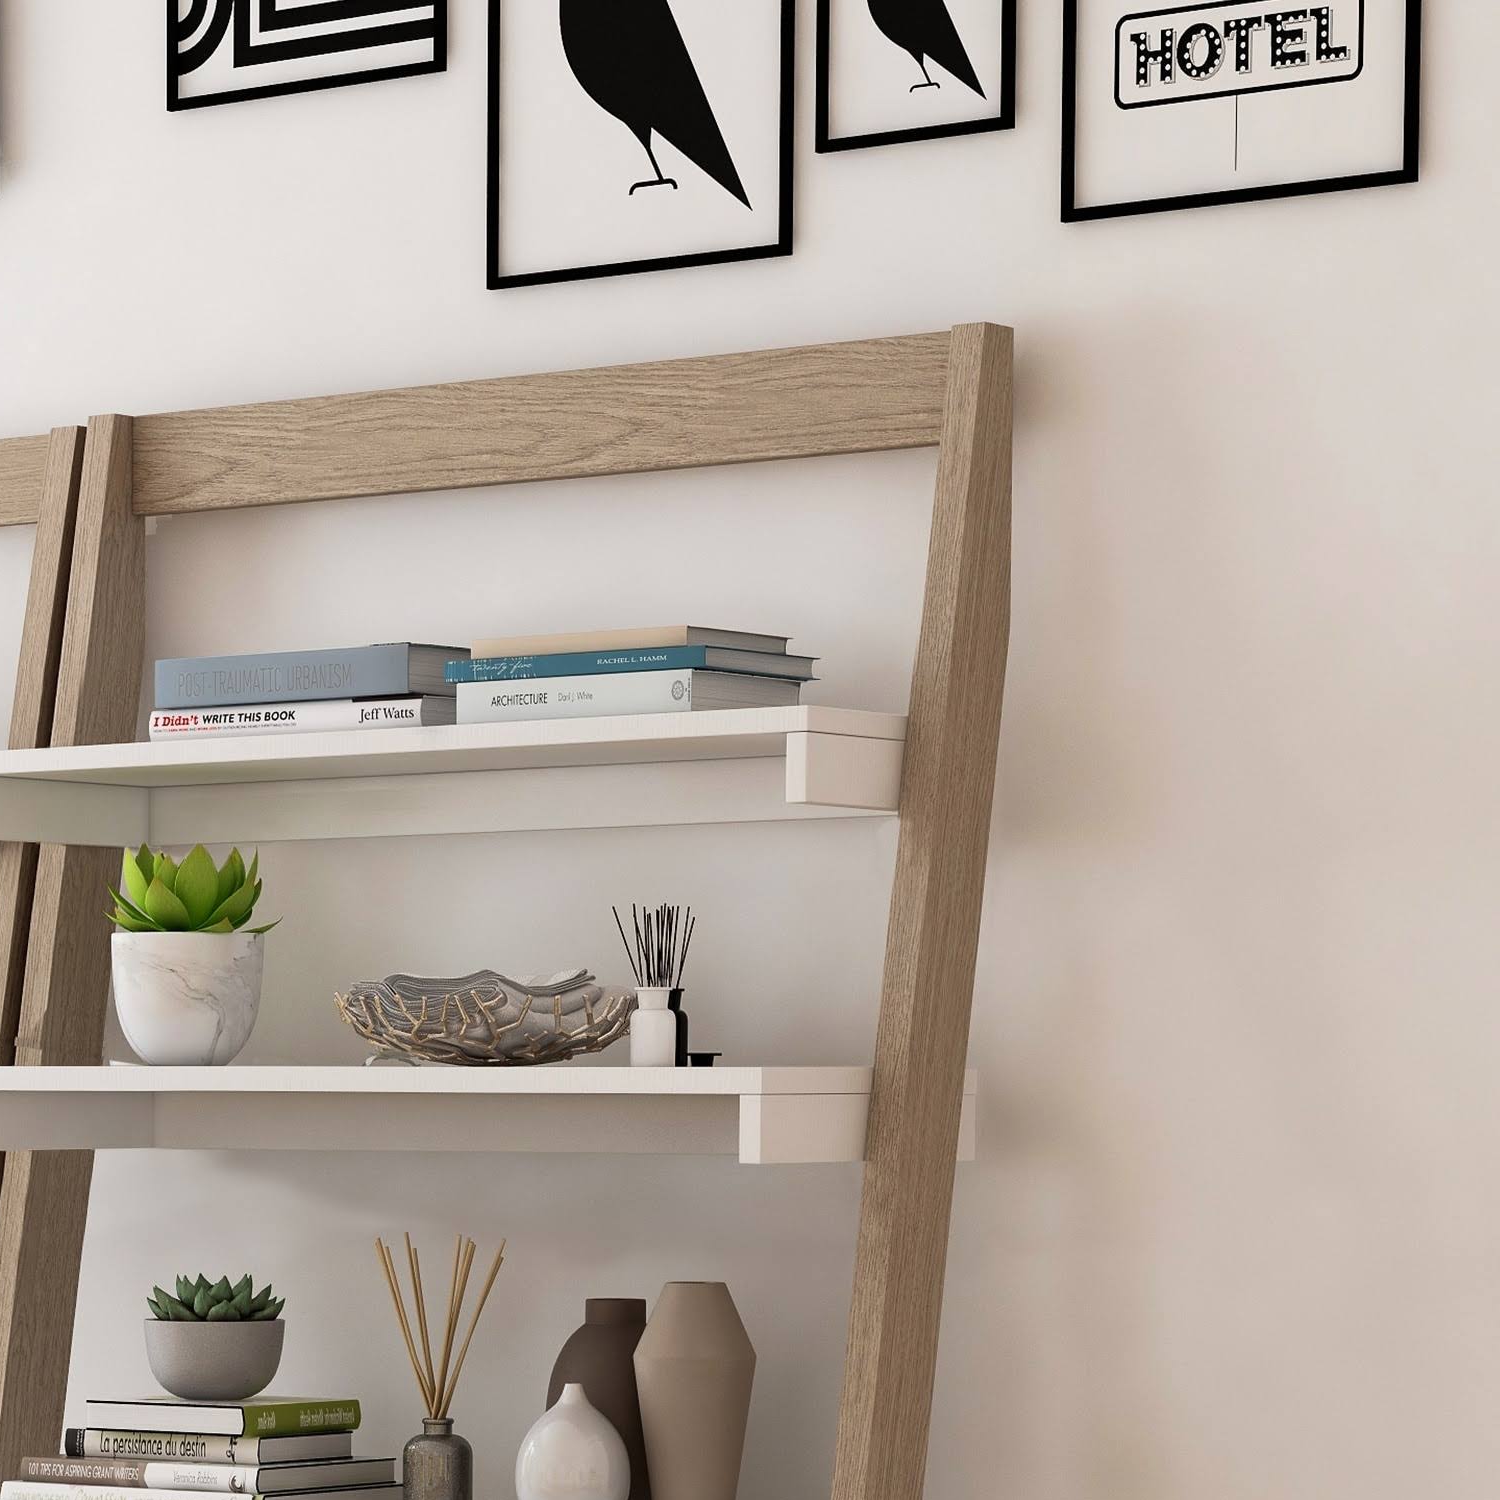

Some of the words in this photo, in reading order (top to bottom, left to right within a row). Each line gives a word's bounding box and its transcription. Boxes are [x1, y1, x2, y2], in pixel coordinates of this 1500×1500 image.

[1130, 6, 1350, 88] HOTEL
[596, 656, 630, 665] RACHEL
[639, 654, 668, 663] HAMM
[177, 667, 282, 698] POST-TRAUMATIC
[286, 662, 353, 693] URBANISM
[490, 692, 548, 707] ARCHITECTURE
[153, 717, 160, 727] I
[161, 714, 199, 727] Didn't
[202, 712, 235, 725] WRITE
[238, 711, 262, 723] THIS
[264, 710, 296, 722] BOOK
[358, 707, 382, 724] Jeff
[382, 706, 415, 720] Watts
[100, 1432, 111, 1453] La
[113, 1433, 163, 1459] persistance
[165, 1434, 177, 1456] du
[179, 1436, 207, 1458] destin
[28, 1462, 39, 1475] 101
[40, 1463, 52, 1476] TIPS
[52, 1464, 65, 1478] FOR
[65, 1465, 92, 1480] ASPIRING
[92, 1465, 114, 1480] GRANT
[114, 1467, 140, 1481] WRITERS
